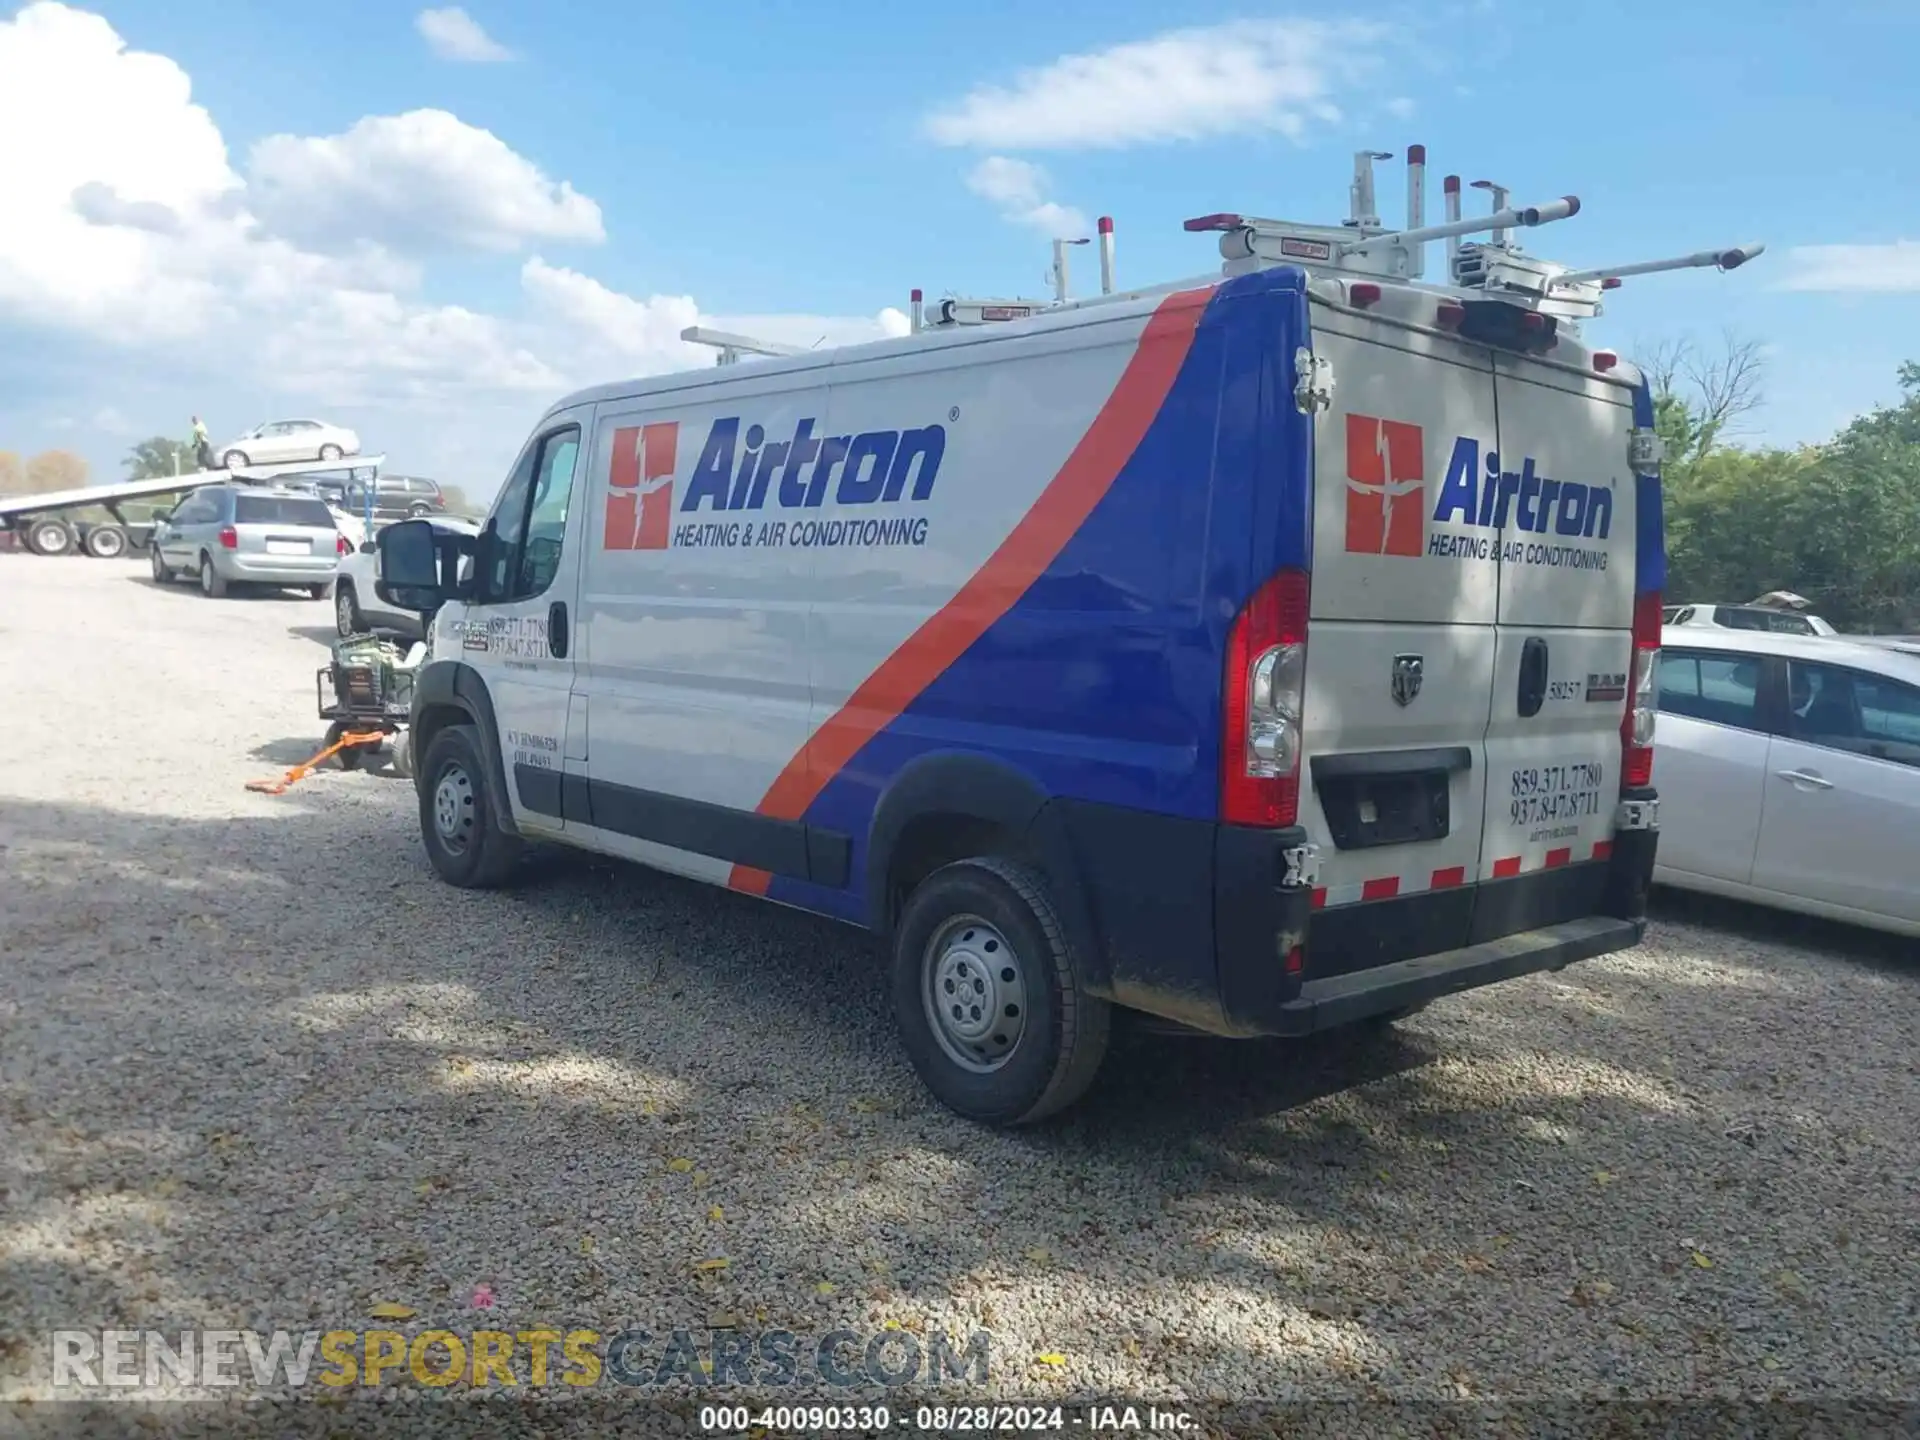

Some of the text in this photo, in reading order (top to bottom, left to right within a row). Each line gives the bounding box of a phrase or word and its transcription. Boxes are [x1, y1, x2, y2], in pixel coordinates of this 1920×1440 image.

[680, 416, 945, 512] Airtron
[1433, 436, 1612, 539] Airtron
[674, 518, 928, 548] HEATING & AIR CONDITIONING
[1428, 533, 1487, 560] HEATING
[1502, 541, 1523, 563] AIR
[1527, 544, 1608, 571] CONDITIONING
[1511, 763, 1602, 797] 859.371.7780
[1510, 791, 1599, 826] 937.847.8711
